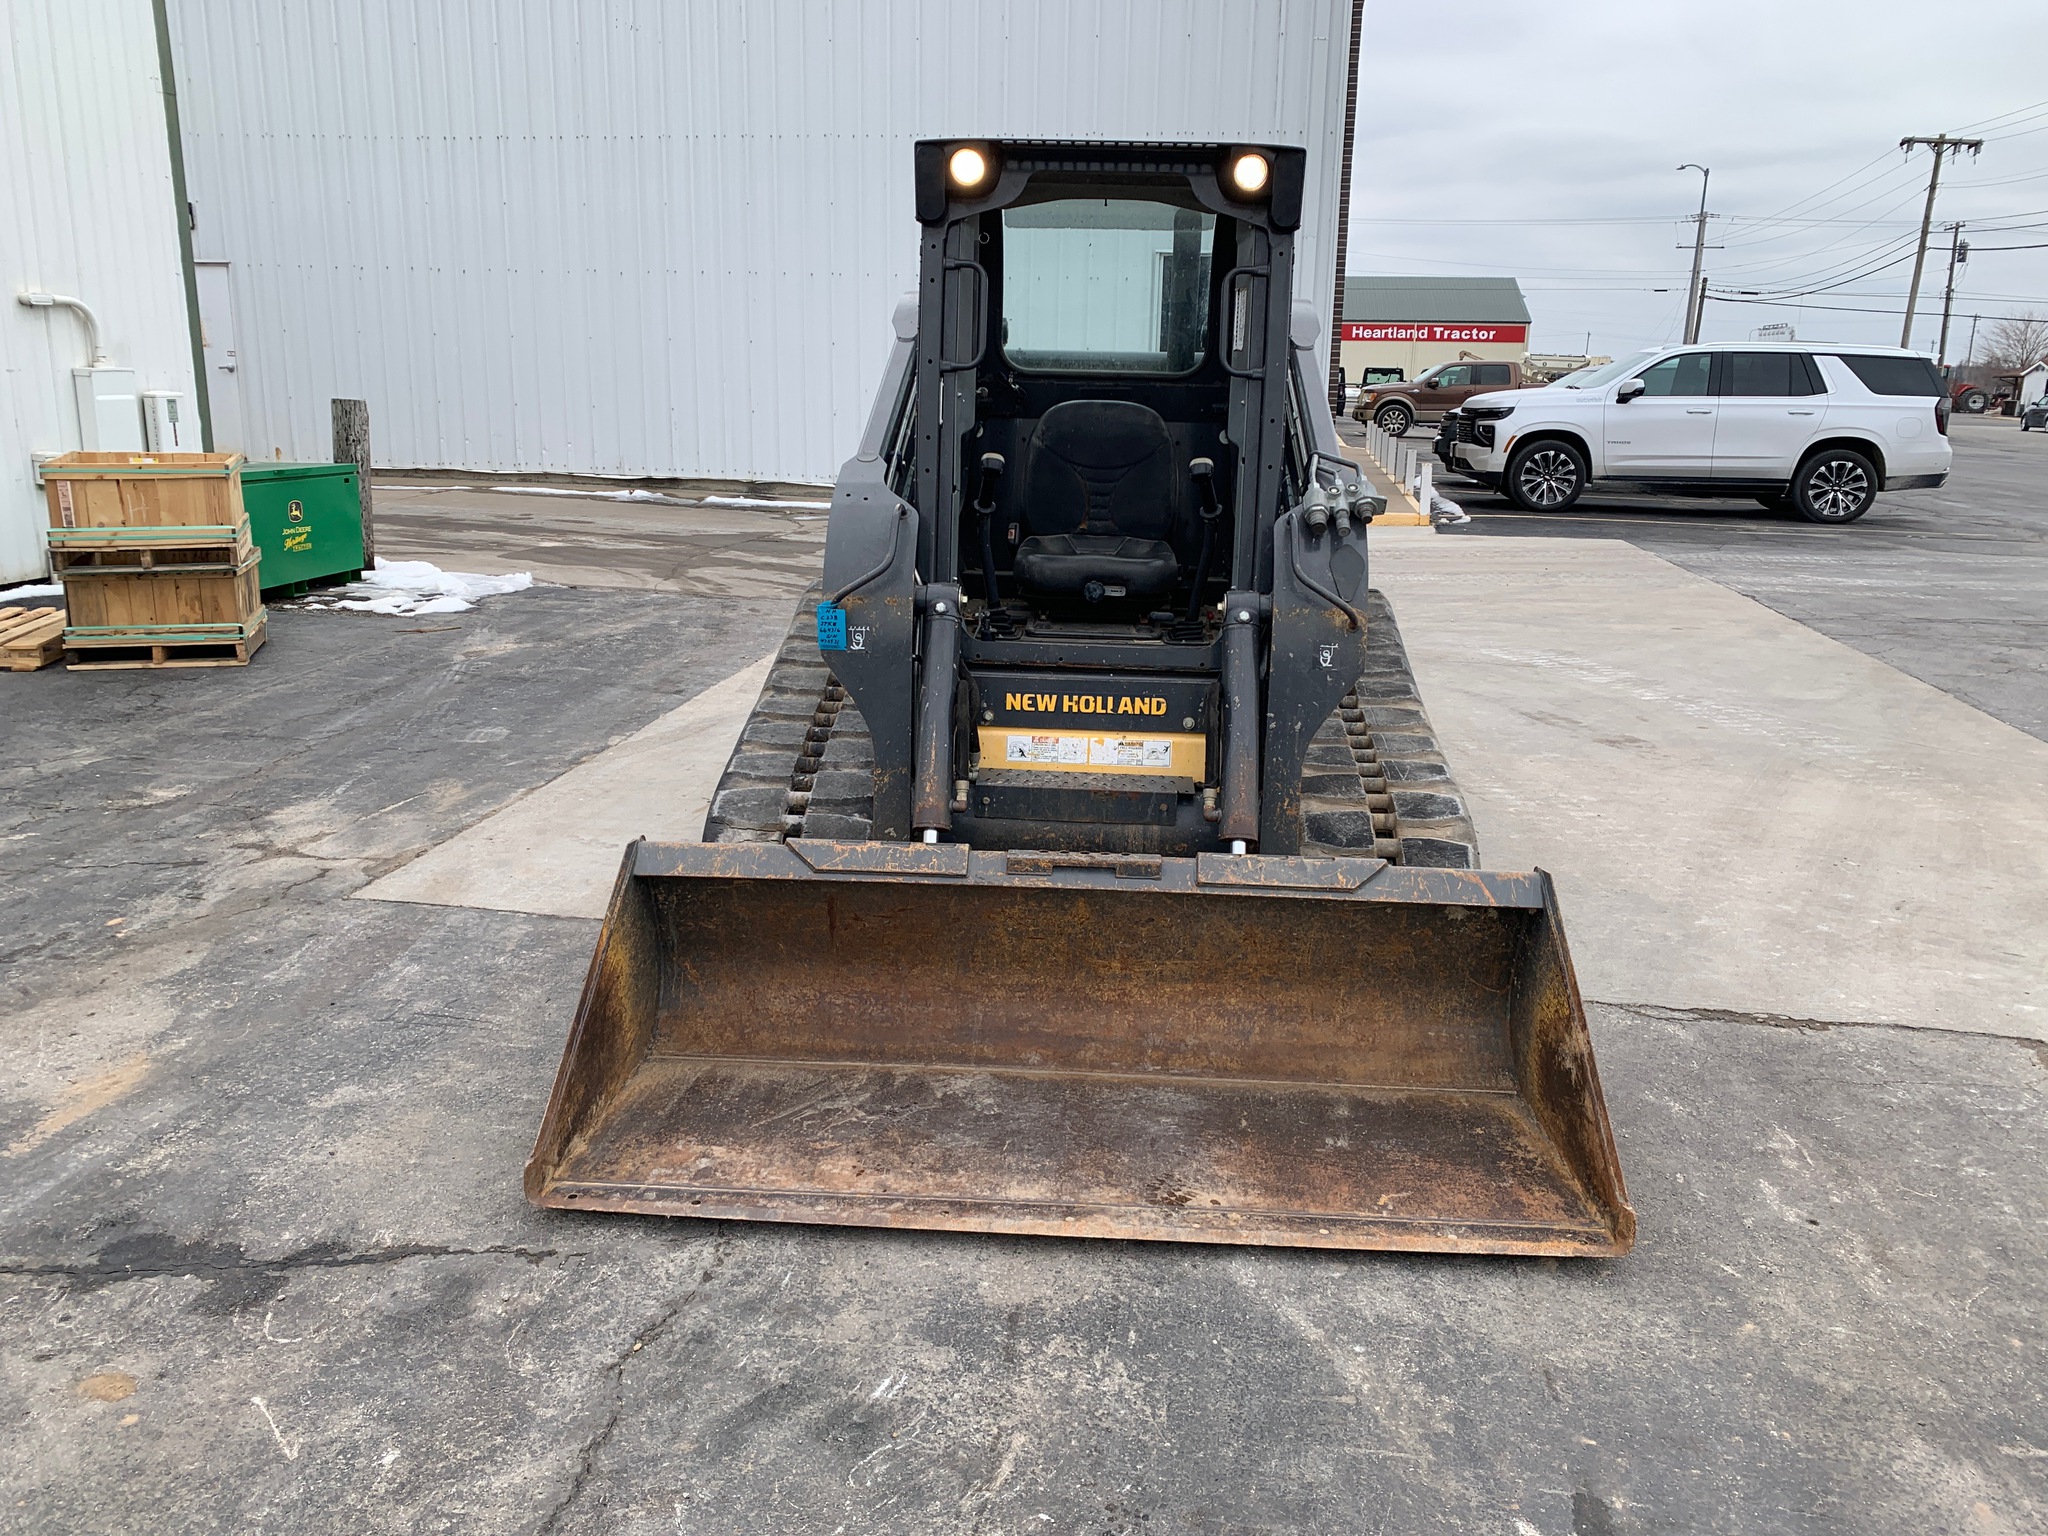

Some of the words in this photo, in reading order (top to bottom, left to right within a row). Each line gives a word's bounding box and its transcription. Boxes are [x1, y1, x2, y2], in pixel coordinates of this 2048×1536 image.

[1352, 325, 1428, 339] Heartland
[1433, 327, 1497, 340] Tractor
[295, 525, 312, 533] DEERE
[1005, 692, 1058, 712] NEW
[1062, 695, 1167, 716] HOLLAND
